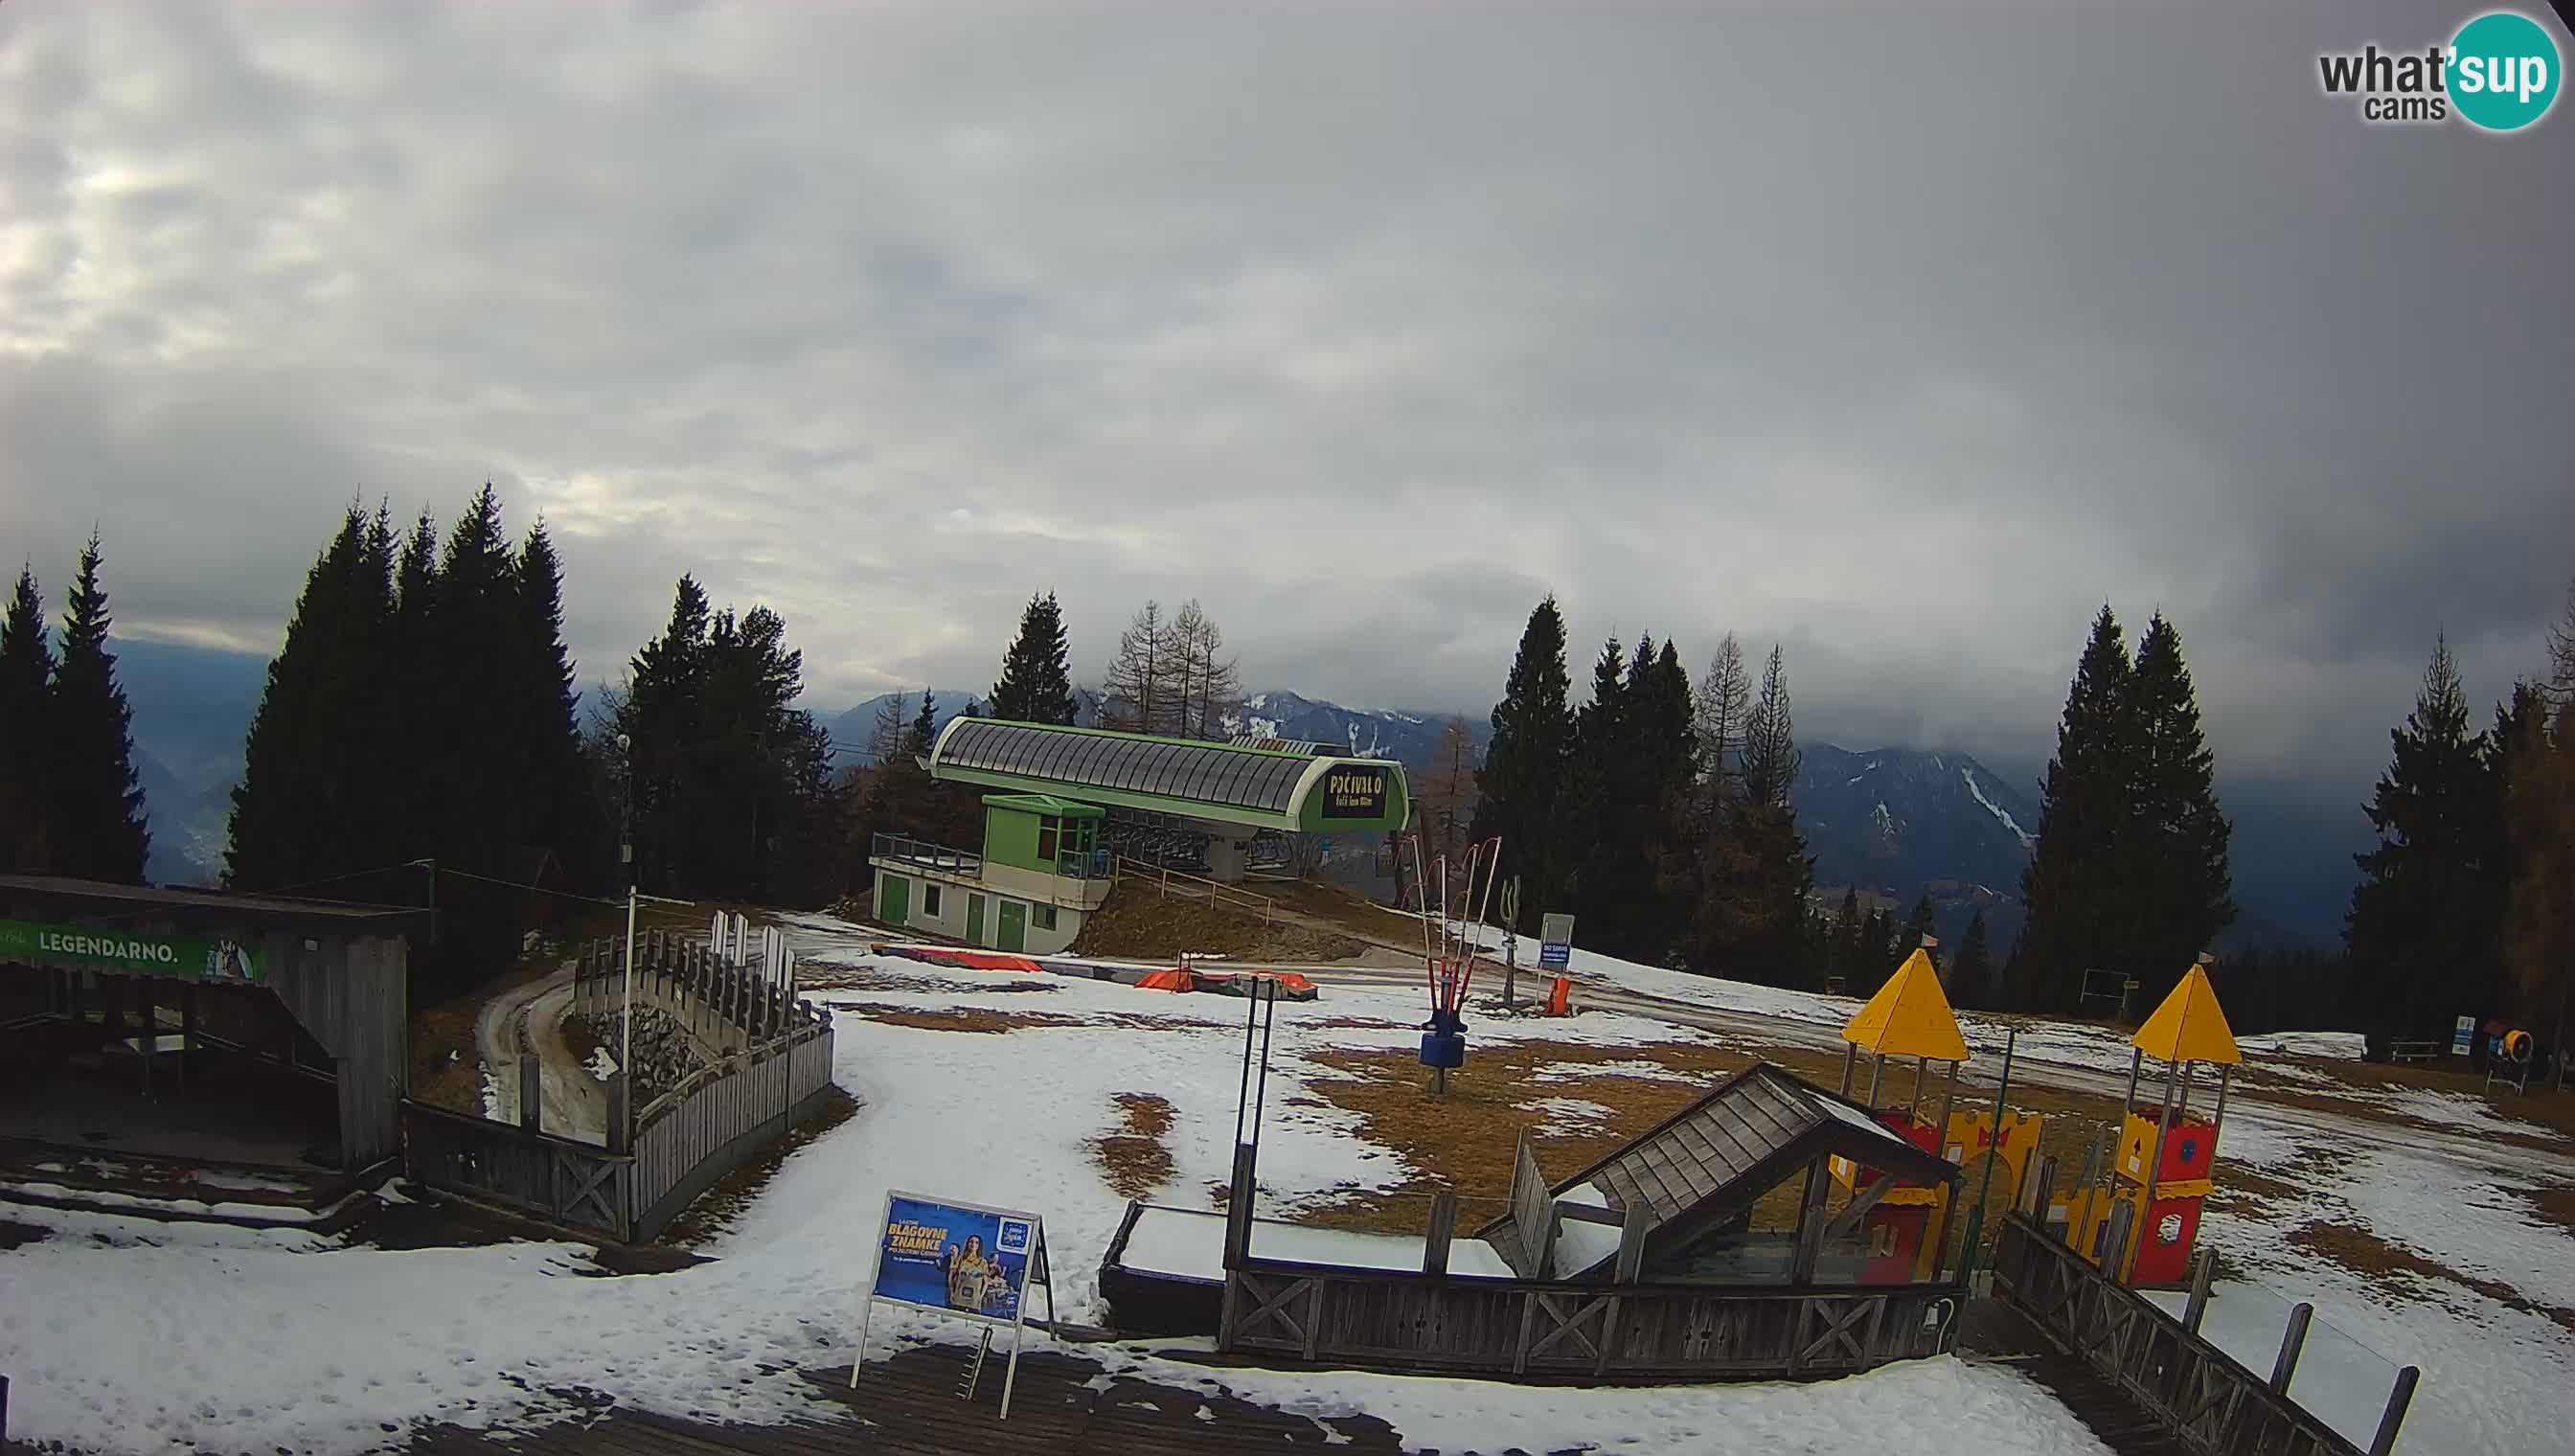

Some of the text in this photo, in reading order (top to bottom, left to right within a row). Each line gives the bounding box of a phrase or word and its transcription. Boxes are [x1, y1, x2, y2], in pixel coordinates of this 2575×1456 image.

[39, 932, 178, 963] LEGENDARNO.
[888, 1223, 948, 1240] BLAGOVNE
[891, 1236, 942, 1250] ZNAMKE
